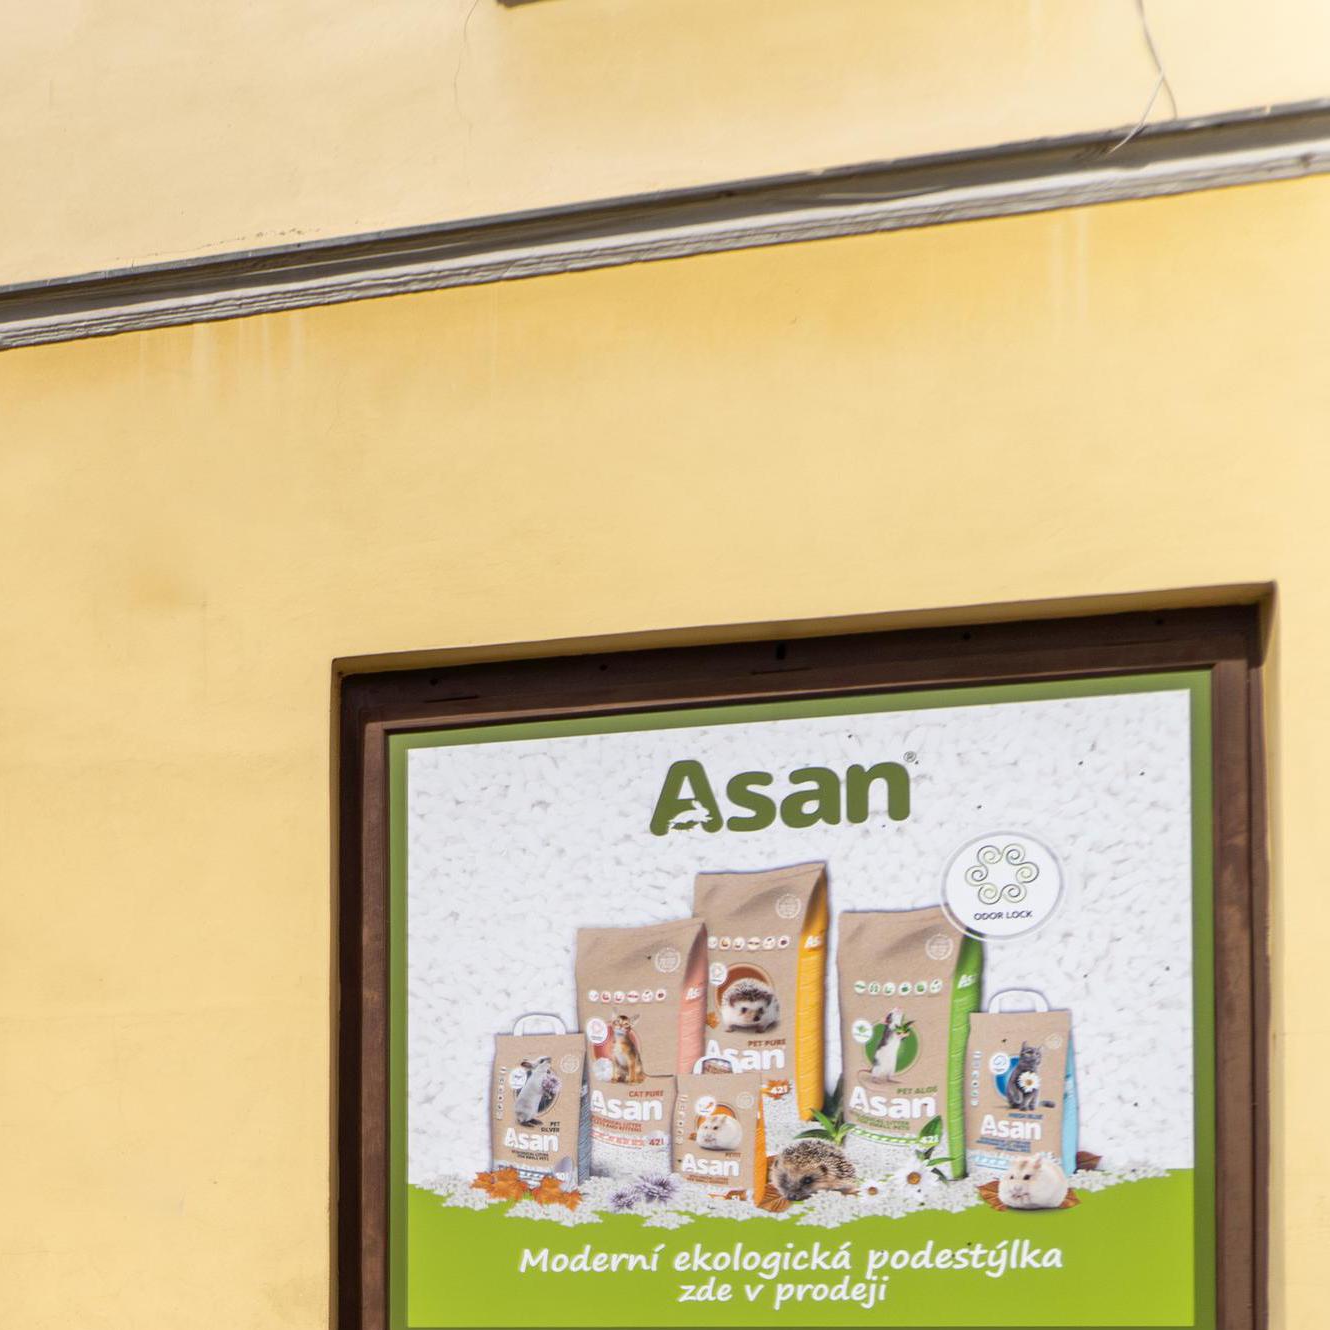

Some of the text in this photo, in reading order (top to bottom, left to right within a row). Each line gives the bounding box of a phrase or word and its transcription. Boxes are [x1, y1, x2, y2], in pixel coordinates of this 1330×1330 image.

[974, 909, 1033, 921] ODOR LOCK
[706, 1040, 785, 1071] Asan
[590, 1090, 663, 1121] Asan
[849, 1086, 936, 1119] Asan
[504, 1127, 559, 1152] Asan
[980, 1114, 1041, 1140] Asan
[682, 1153, 739, 1176] Asan
[519, 1239, 1064, 1280] Moderní ekologická podestýlka
[677, 1275, 888, 1309] zde v prodeji
